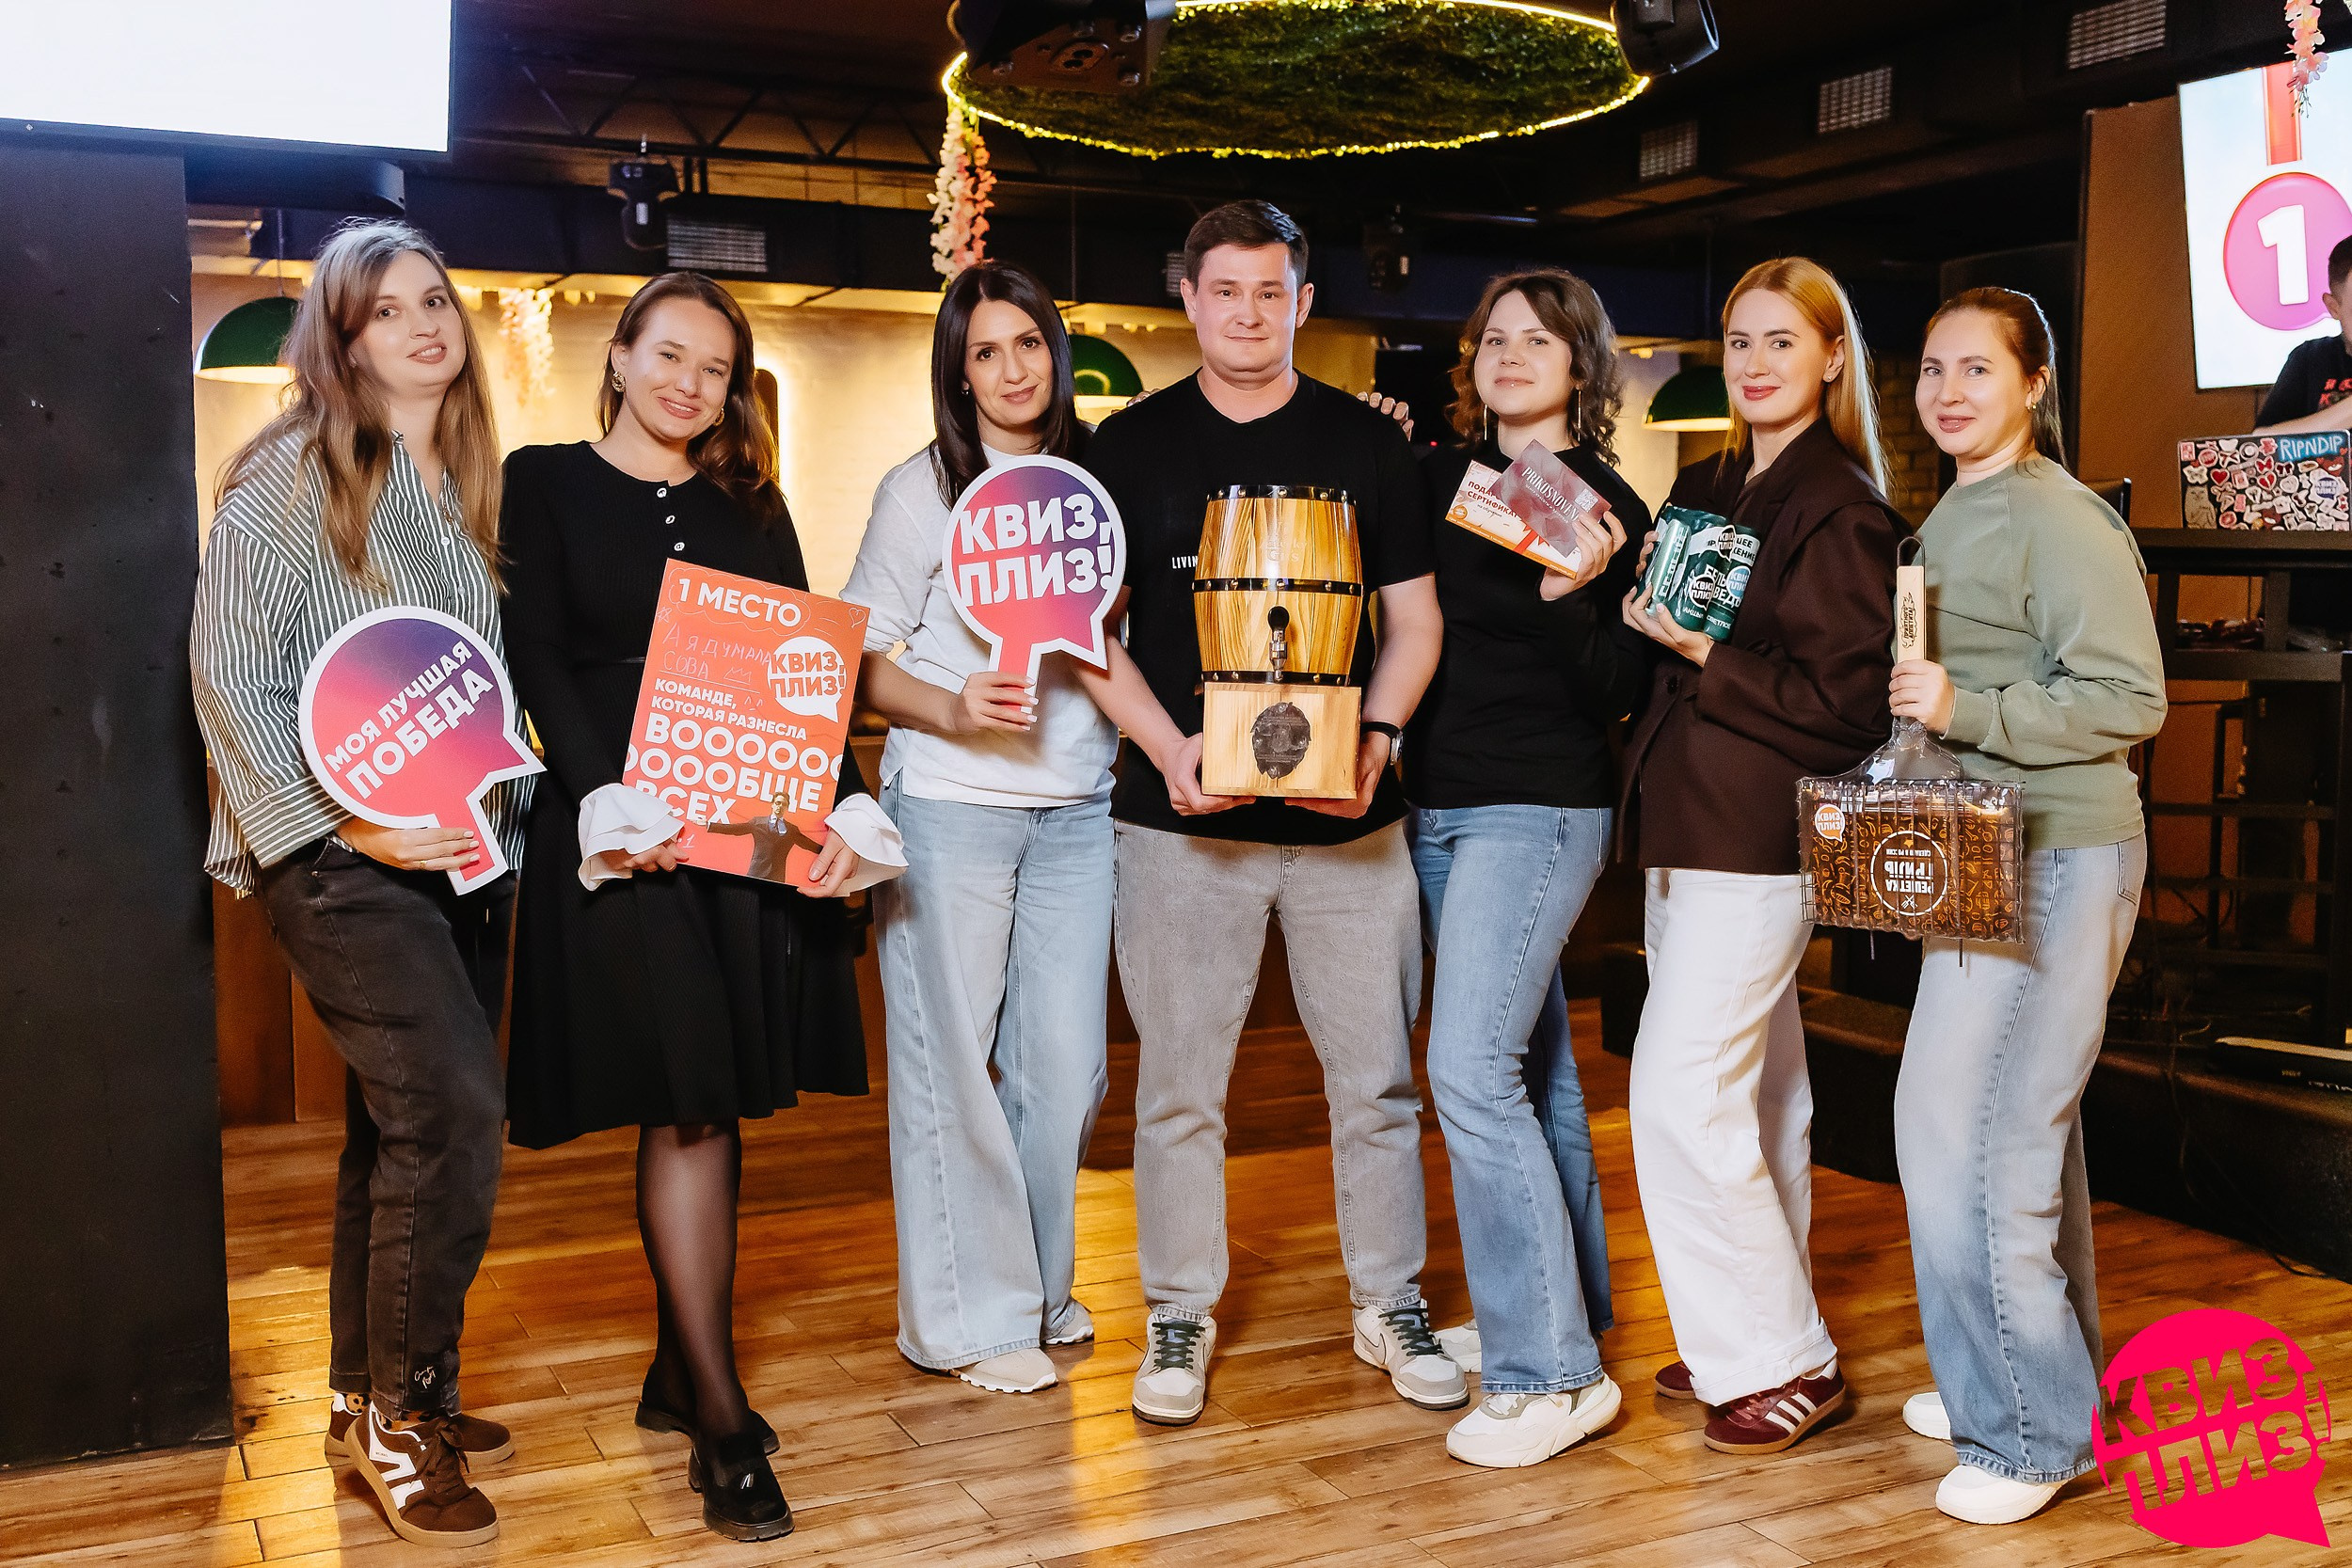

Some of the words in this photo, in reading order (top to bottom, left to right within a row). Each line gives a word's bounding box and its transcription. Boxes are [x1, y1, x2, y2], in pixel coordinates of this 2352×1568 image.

[2257, 204, 2310, 306] 1
[2280, 436, 2343, 460] RIPNDIP
[960, 493, 1113, 555] КВИЗ,
[959, 546, 1114, 607] ПЛИЗ!
[678, 578, 691, 602] 1
[698, 582, 802, 628] МЕСТО
[663, 650, 709, 680] СОВА
[769, 675, 845, 698] ПЛИЗ!
[325, 720, 382, 773] МОЯ
[377, 641, 473, 729] ЛУЧШАЯ
[655, 678, 737, 709] КОМАНДЕ,
[344, 668, 494, 800] ПОБЕДА
[651, 695, 725, 723] КОТОРАЯ
[728, 712, 808, 741] РАЗНЕСЛА
[1884, 861, 1934, 880] ГРИЛЬ
[1884, 879, 1934, 895] РЕШЕТКА
